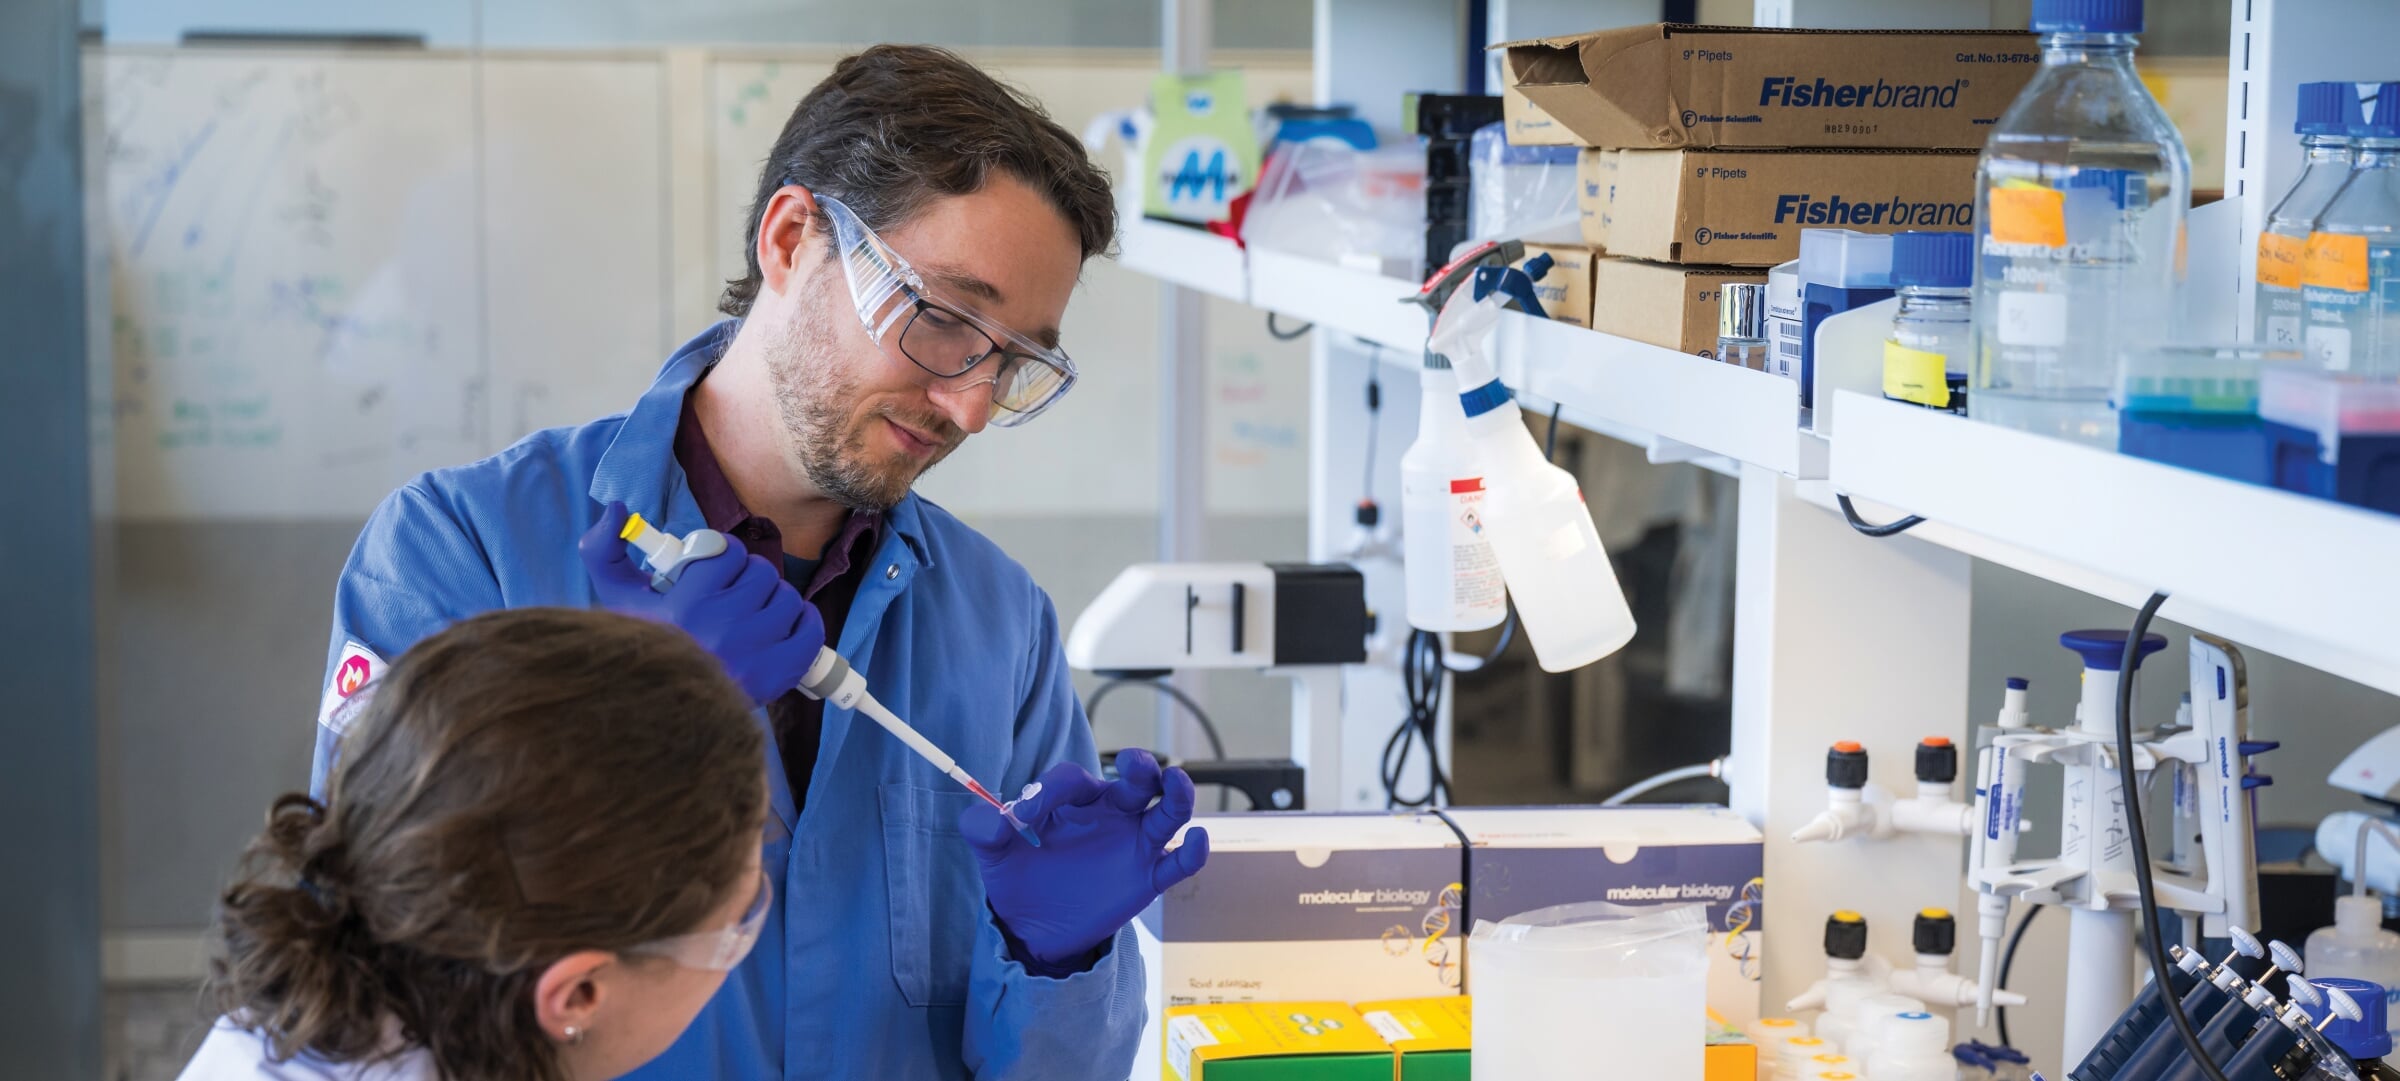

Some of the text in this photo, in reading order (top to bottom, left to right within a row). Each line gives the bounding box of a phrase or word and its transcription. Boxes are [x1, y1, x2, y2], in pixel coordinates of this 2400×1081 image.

[1698, 50, 1733, 63] Pipets
[1699, 115, 1724, 123] Fisher
[1725, 115, 1763, 123] Scientific
[1712, 167, 1747, 181] Pipets
[1713, 232, 1738, 240] Fisher
[1740, 232, 1778, 241] Scientific
[1299, 888, 1431, 905] molecular biology
[1607, 883, 1735, 901] molecular biology
